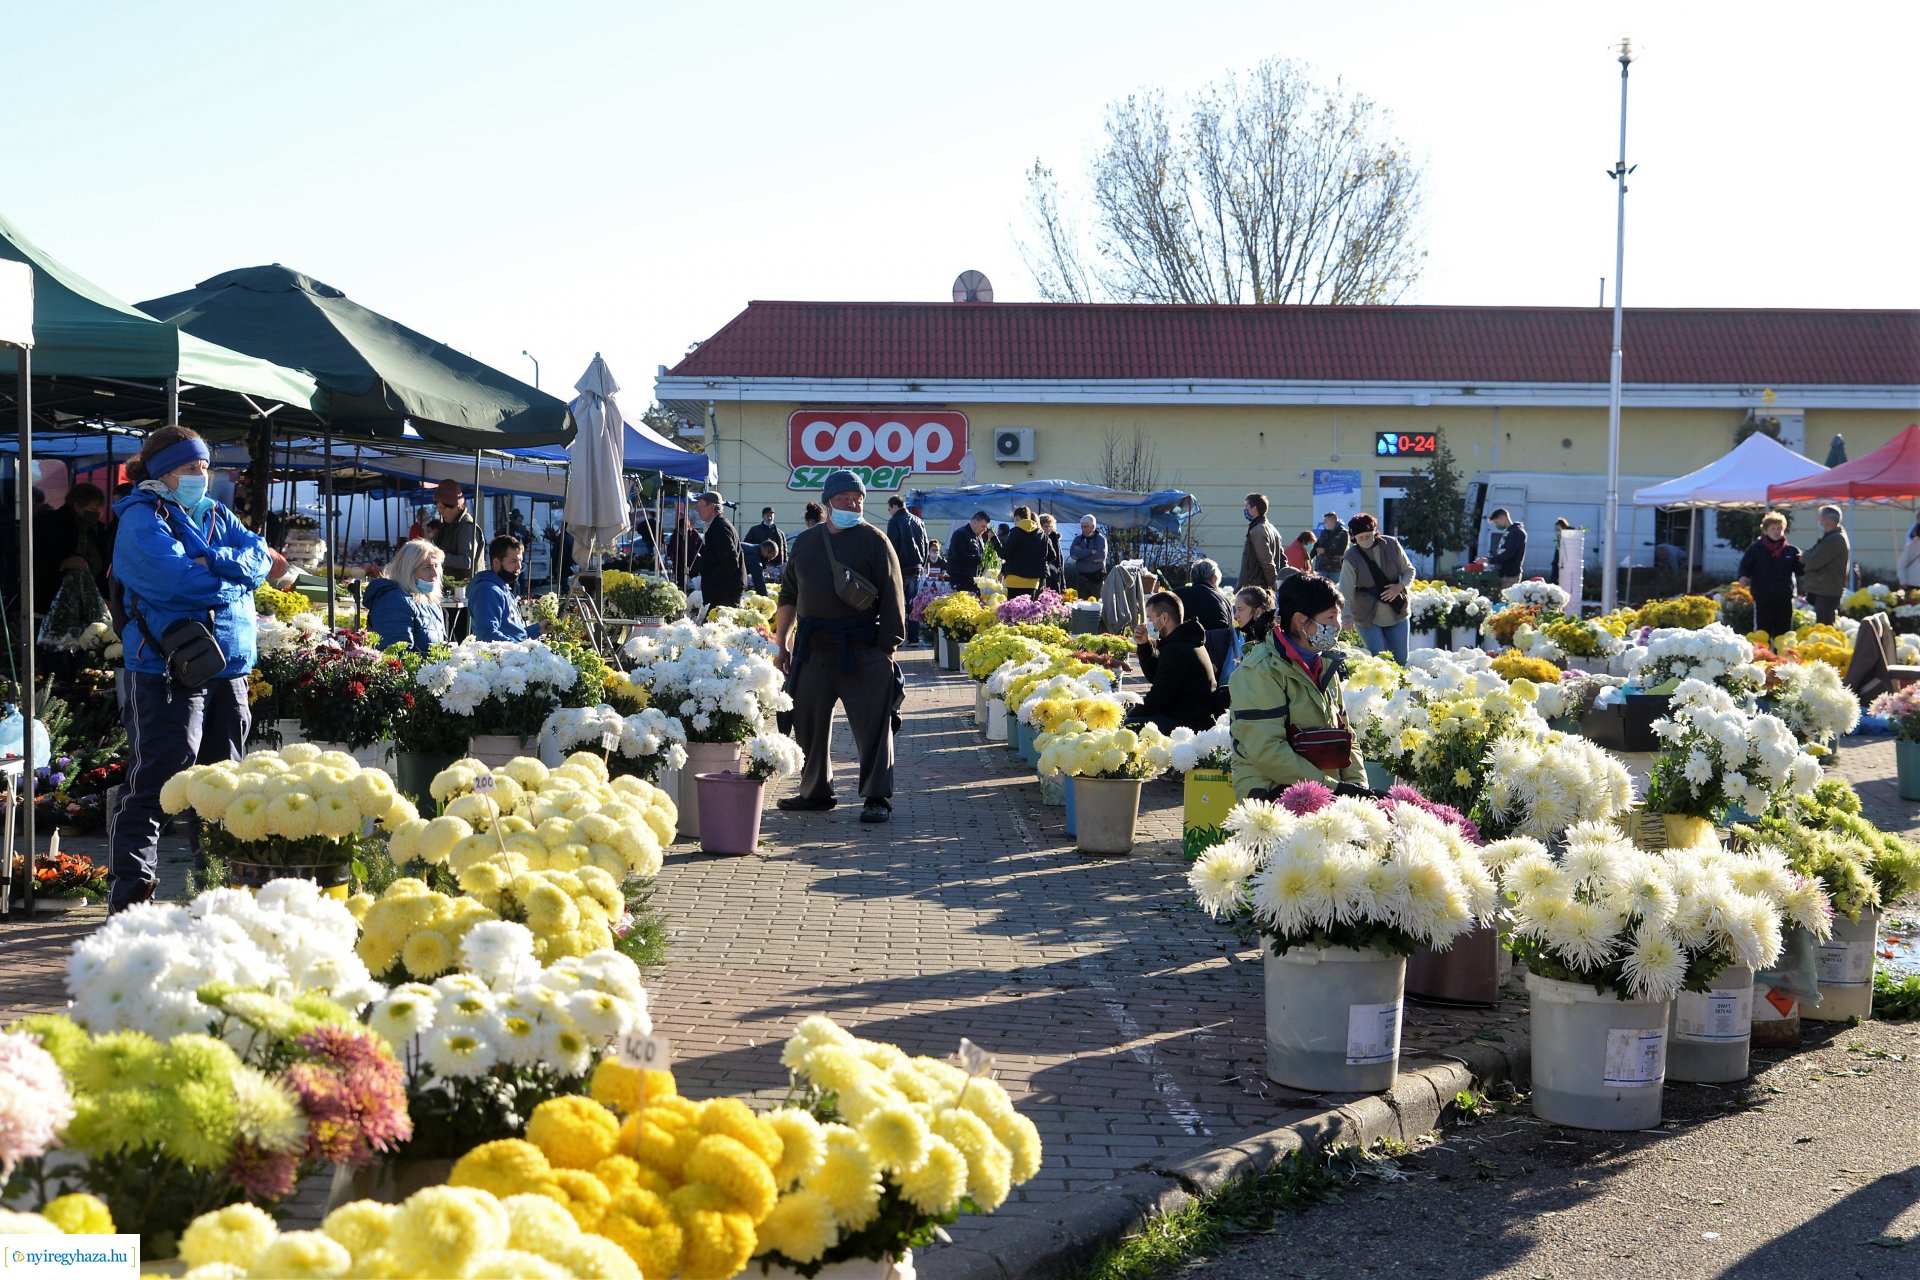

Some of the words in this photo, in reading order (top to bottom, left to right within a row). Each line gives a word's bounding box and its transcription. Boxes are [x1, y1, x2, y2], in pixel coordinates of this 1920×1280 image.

[1398, 435, 1436, 452] 0-24
[791, 465, 911, 489] szper
[475, 776, 494, 788] 200
[625, 1036, 656, 1062] 400
